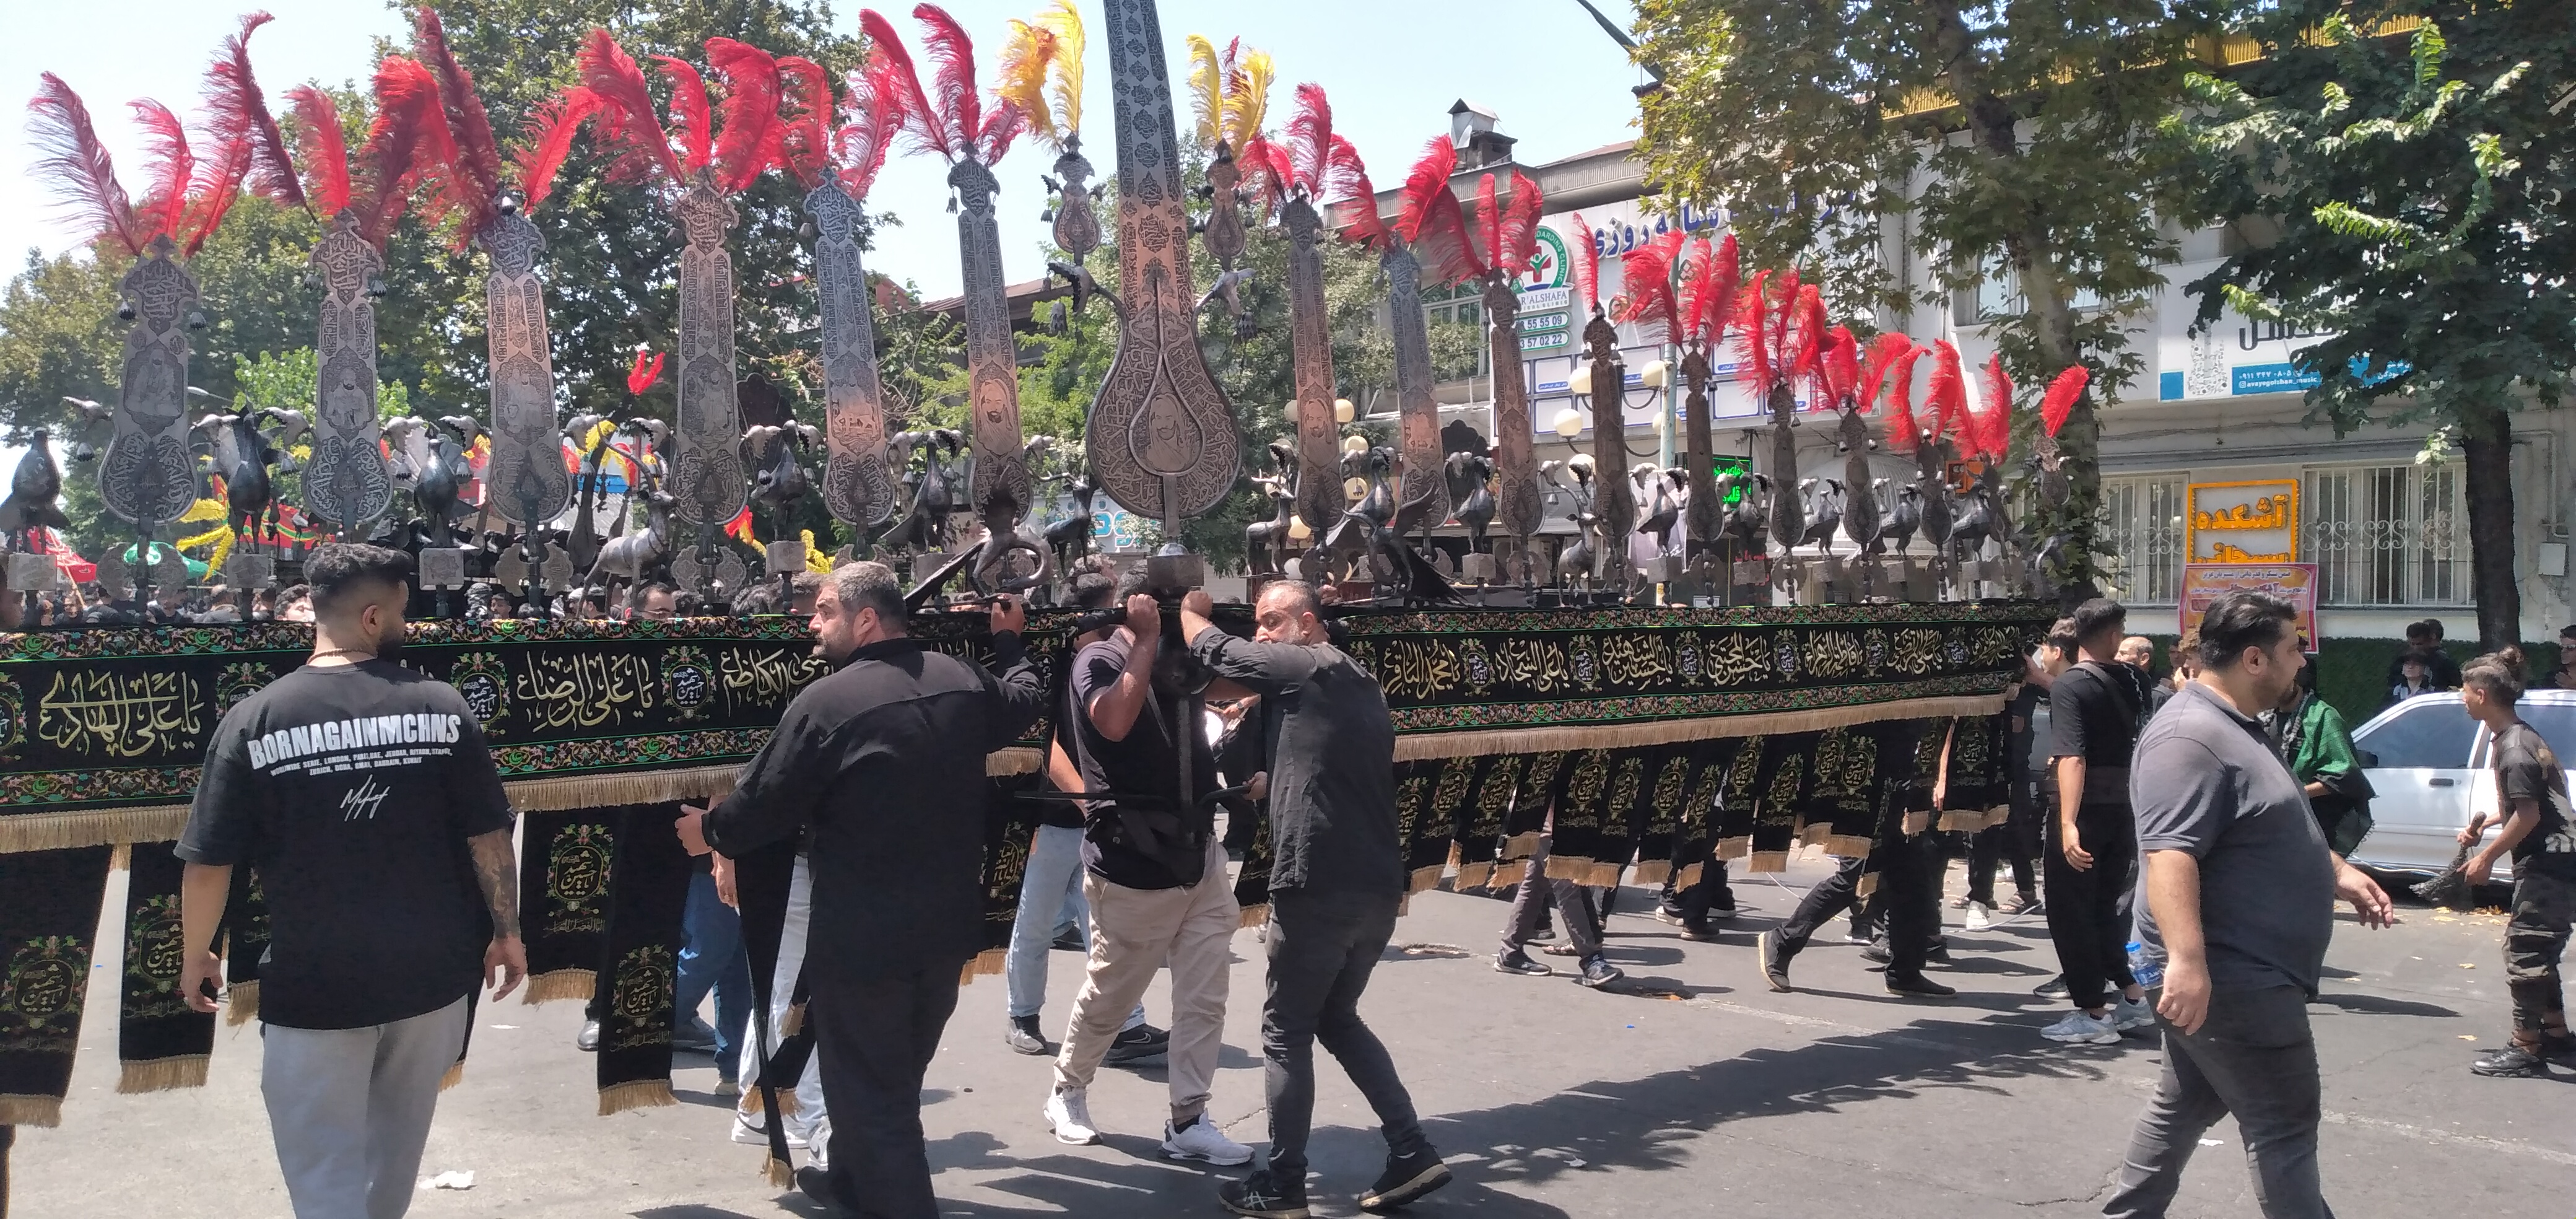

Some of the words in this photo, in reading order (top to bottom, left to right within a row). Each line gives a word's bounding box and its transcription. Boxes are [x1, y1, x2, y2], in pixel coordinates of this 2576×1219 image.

[1537, 230, 1564, 253] OARDING
[1557, 253, 1566, 282] CLINIC
[1520, 291, 1567, 305] R'ALSHAFA
[1527, 318, 1538, 329] 55
[1539, 317, 1550, 328] 55
[1552, 315, 1562, 326] 09
[1527, 338, 1538, 347] 57
[1539, 335, 1550, 346] 02
[1552, 333, 1562, 344] 22
[2196, 494, 2289, 531] آشکده
[247, 713, 461, 770] BORNAGAINMCHNS
